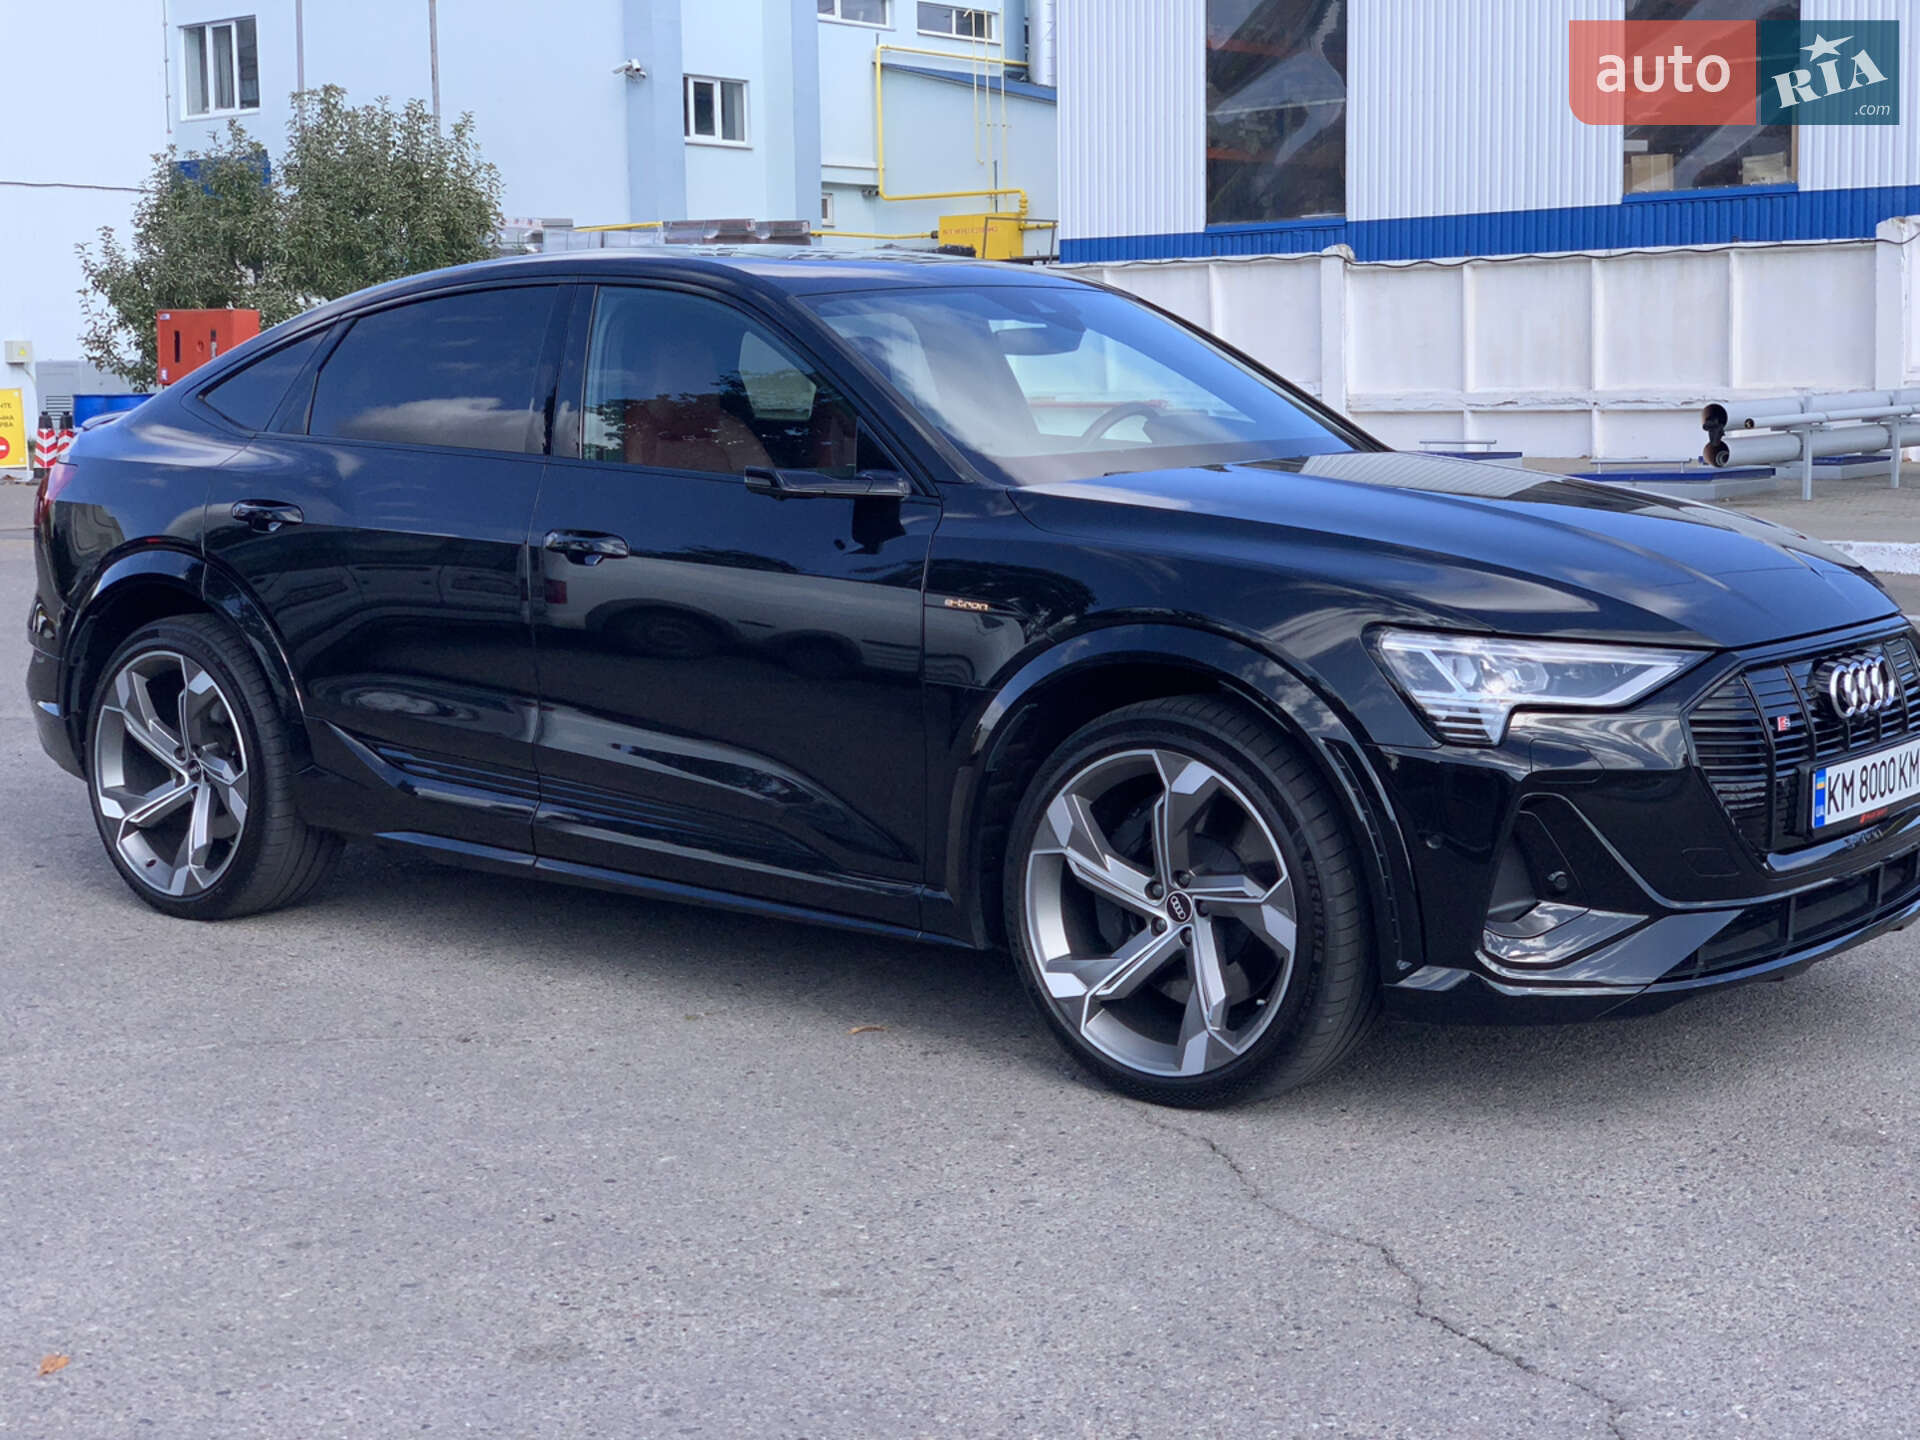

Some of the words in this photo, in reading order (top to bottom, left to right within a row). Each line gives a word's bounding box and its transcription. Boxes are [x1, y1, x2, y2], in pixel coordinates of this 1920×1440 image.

[944, 598, 989, 611] e-tron
[1827, 769, 1855, 815] KM
[1859, 756, 1896, 803] 8000
[1898, 748, 1920, 791] KM
